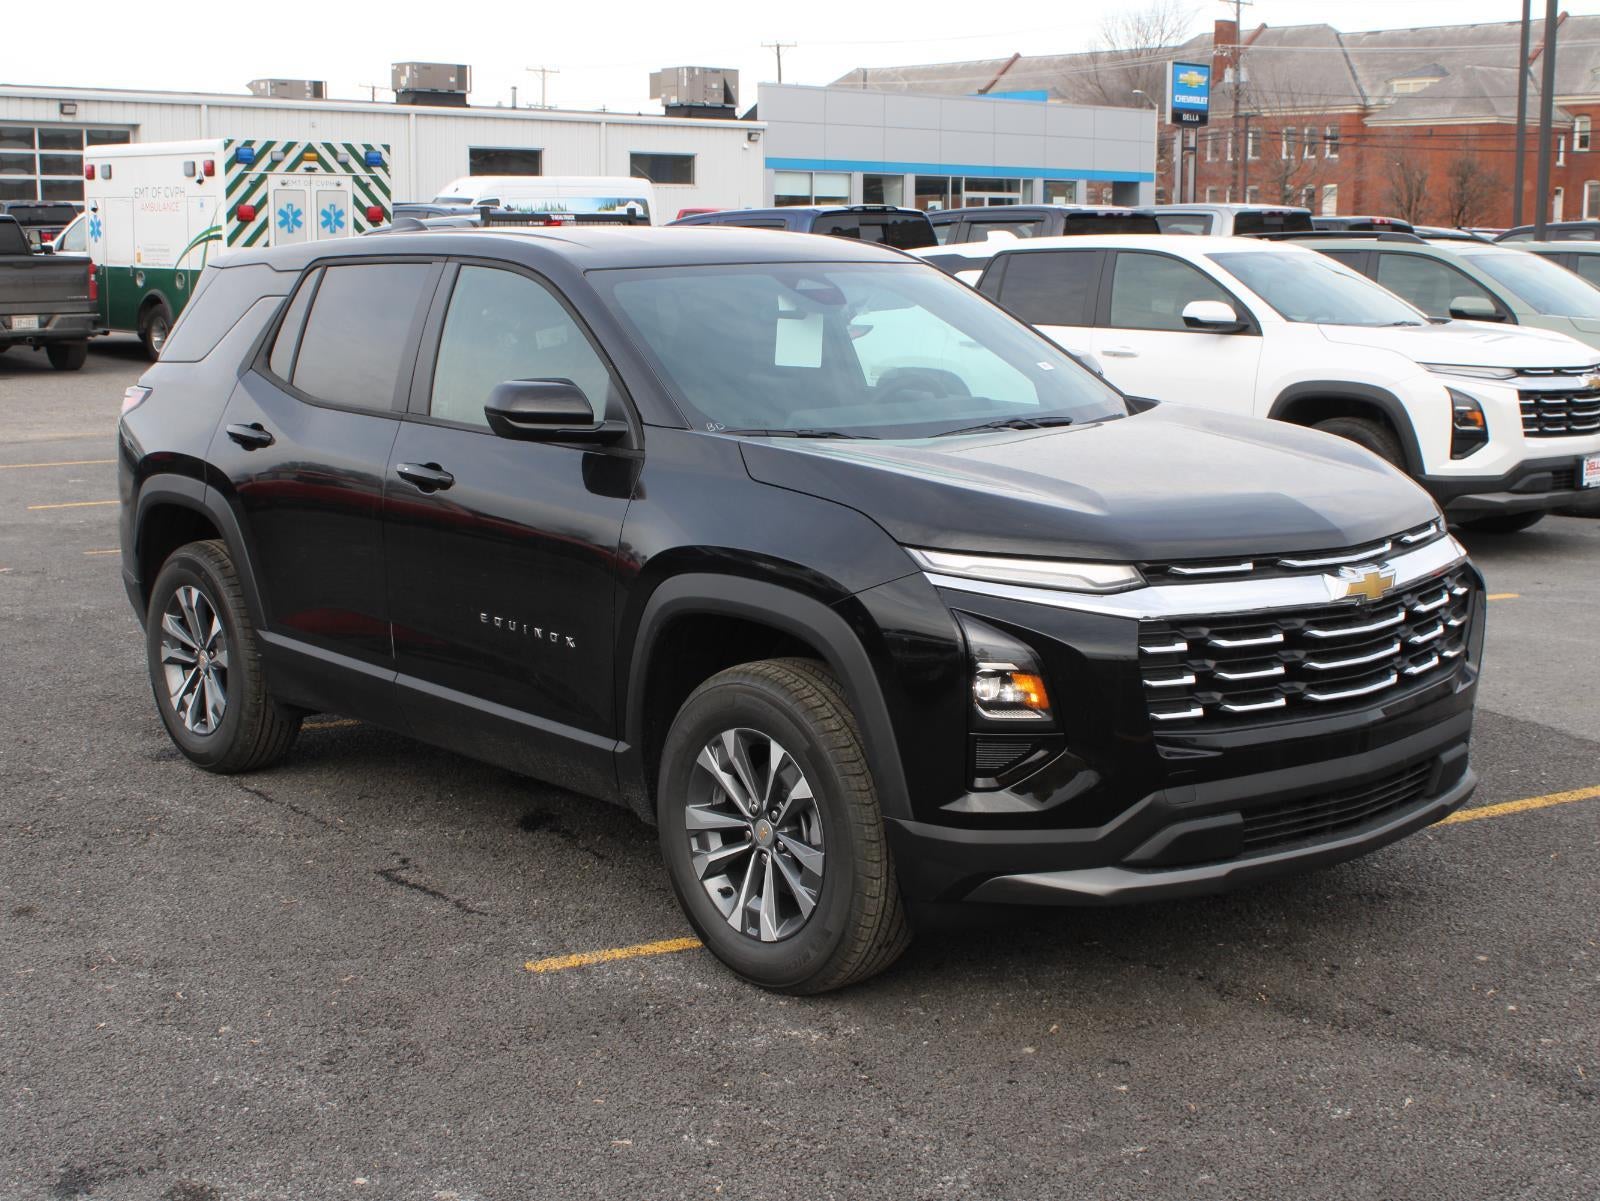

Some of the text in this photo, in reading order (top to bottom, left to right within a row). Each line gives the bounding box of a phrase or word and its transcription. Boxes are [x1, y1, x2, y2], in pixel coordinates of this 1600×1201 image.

[1175, 95, 1208, 104] CHEVROLET
[1182, 113, 1199, 121] DELLA
[134, 187, 185, 199] EMT OF CVPH
[140, 202, 180, 212] AMBULANCE
[480, 612, 576, 648] EQUINOX
